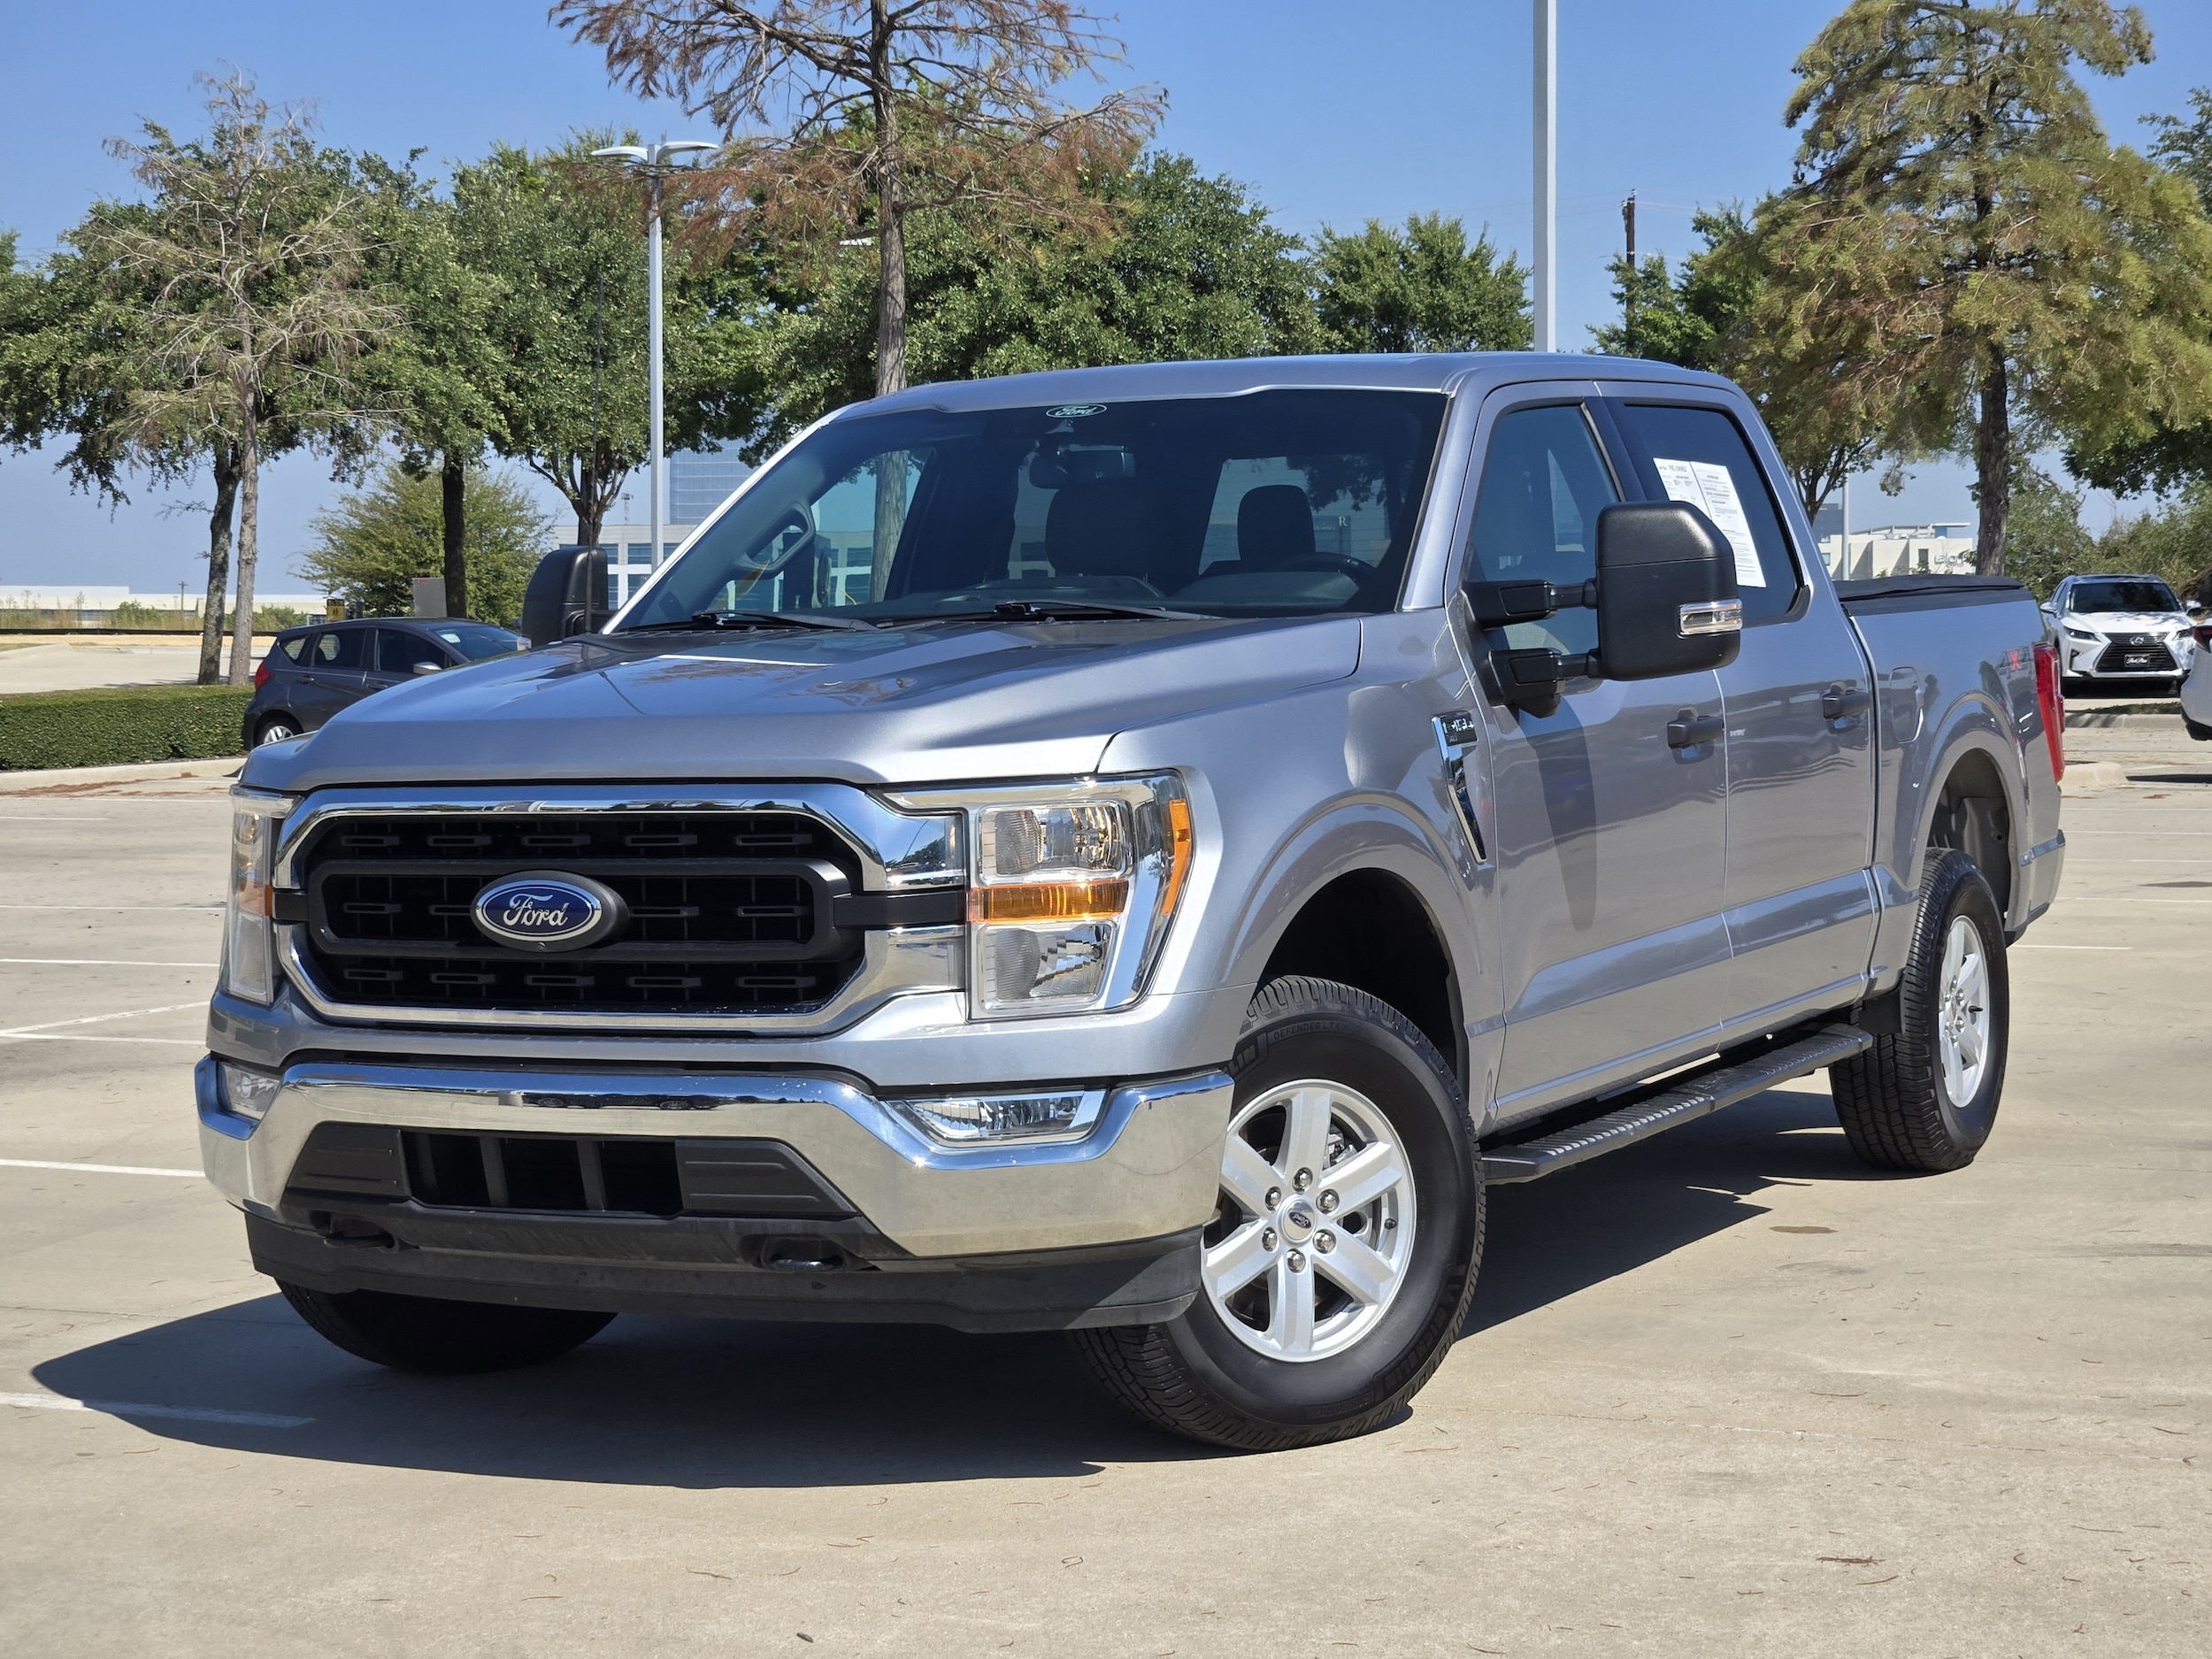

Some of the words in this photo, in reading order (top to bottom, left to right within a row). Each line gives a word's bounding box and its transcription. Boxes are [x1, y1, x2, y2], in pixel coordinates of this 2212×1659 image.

[1055, 405, 1097, 416] Ford
[1339, 516, 1348, 526] R
[503, 893, 569, 926] Ford
[1273, 1022, 1321, 1041] DEFENDER
[1292, 1213, 1310, 1227] Ford
